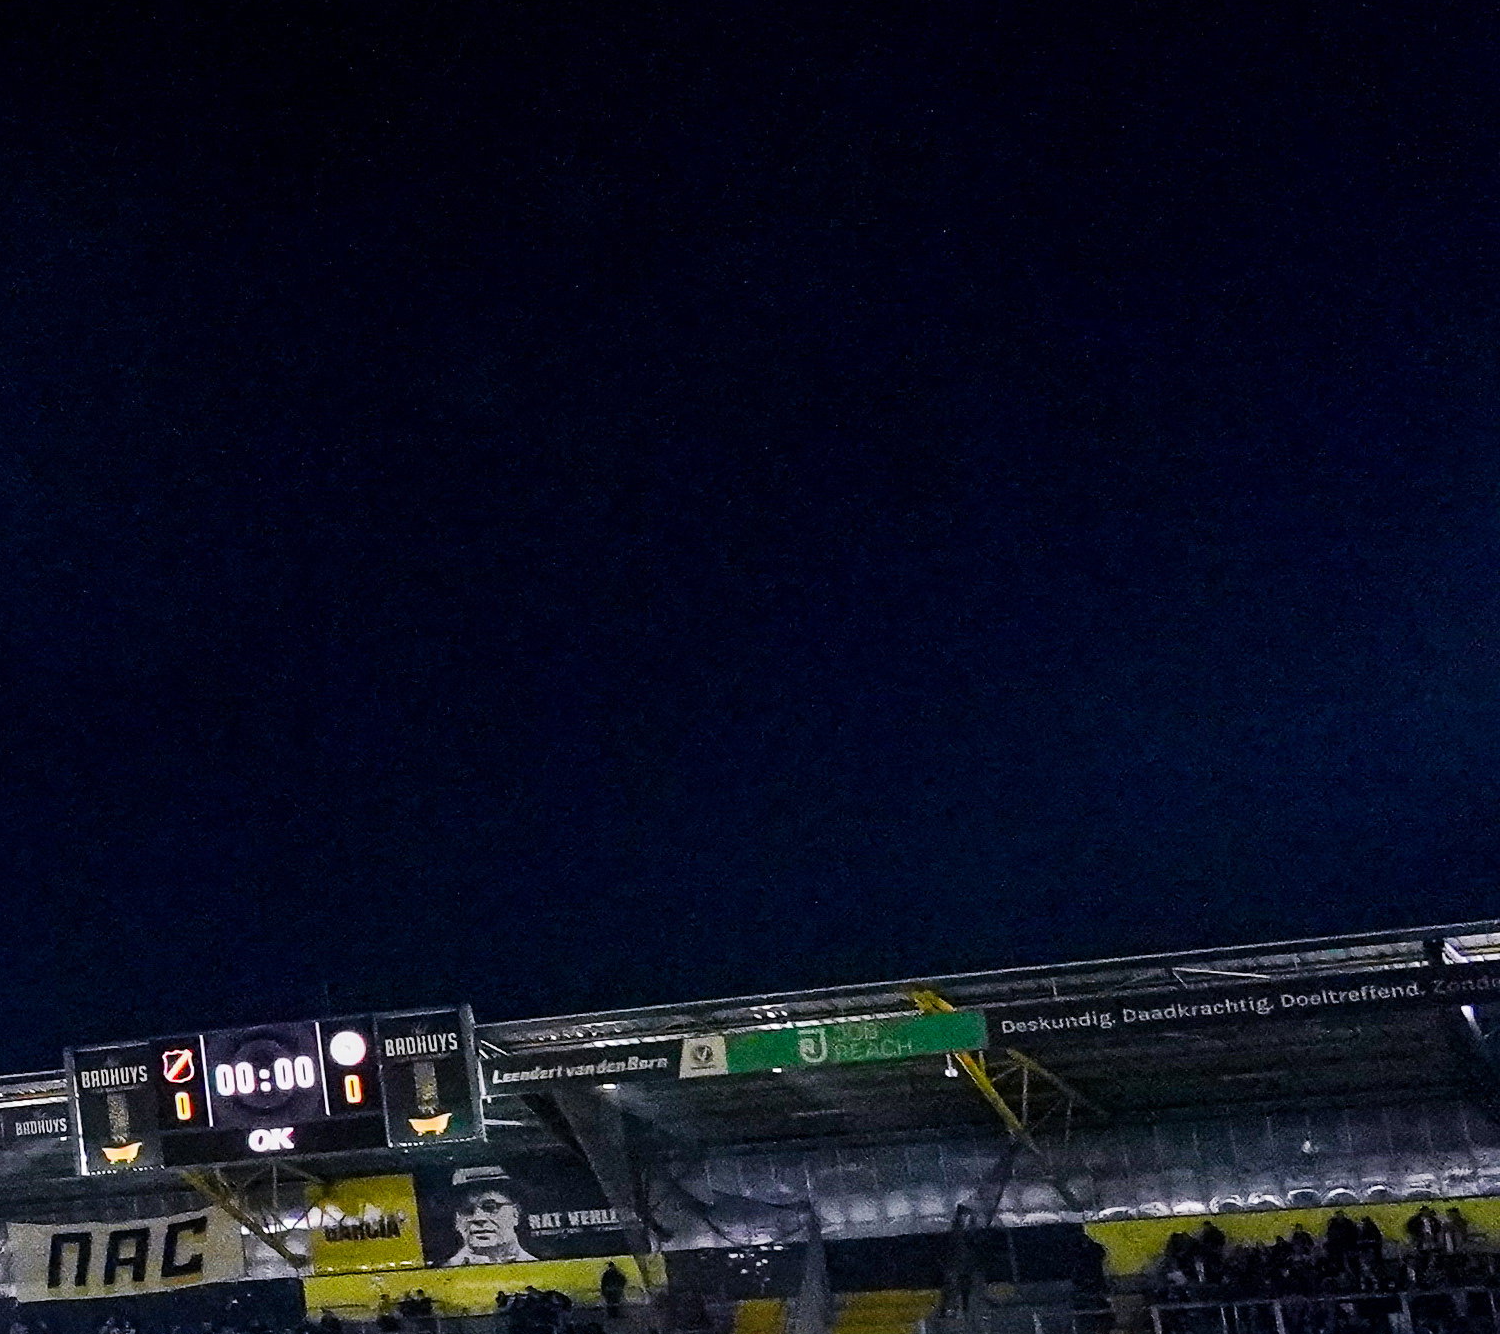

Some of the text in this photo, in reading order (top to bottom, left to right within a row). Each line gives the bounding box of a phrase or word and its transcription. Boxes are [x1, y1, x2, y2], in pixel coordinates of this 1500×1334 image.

[1000, 980, 1427, 1037] Deskundig. Daadkrachtig. Doeltreffend.
[384, 1032, 459, 1058] BADHUYS
[81, 1066, 148, 1089] BADHUYS
[214, 1055, 315, 1097] 00:00
[492, 1065, 564, 1084] Leendert
[595, 1060, 627, 1076] den
[344, 1073, 363, 1105] 0
[173, 1090, 192, 1122] 0
[14, 1118, 68, 1137] BADHUYS
[248, 1126, 295, 1153] OK
